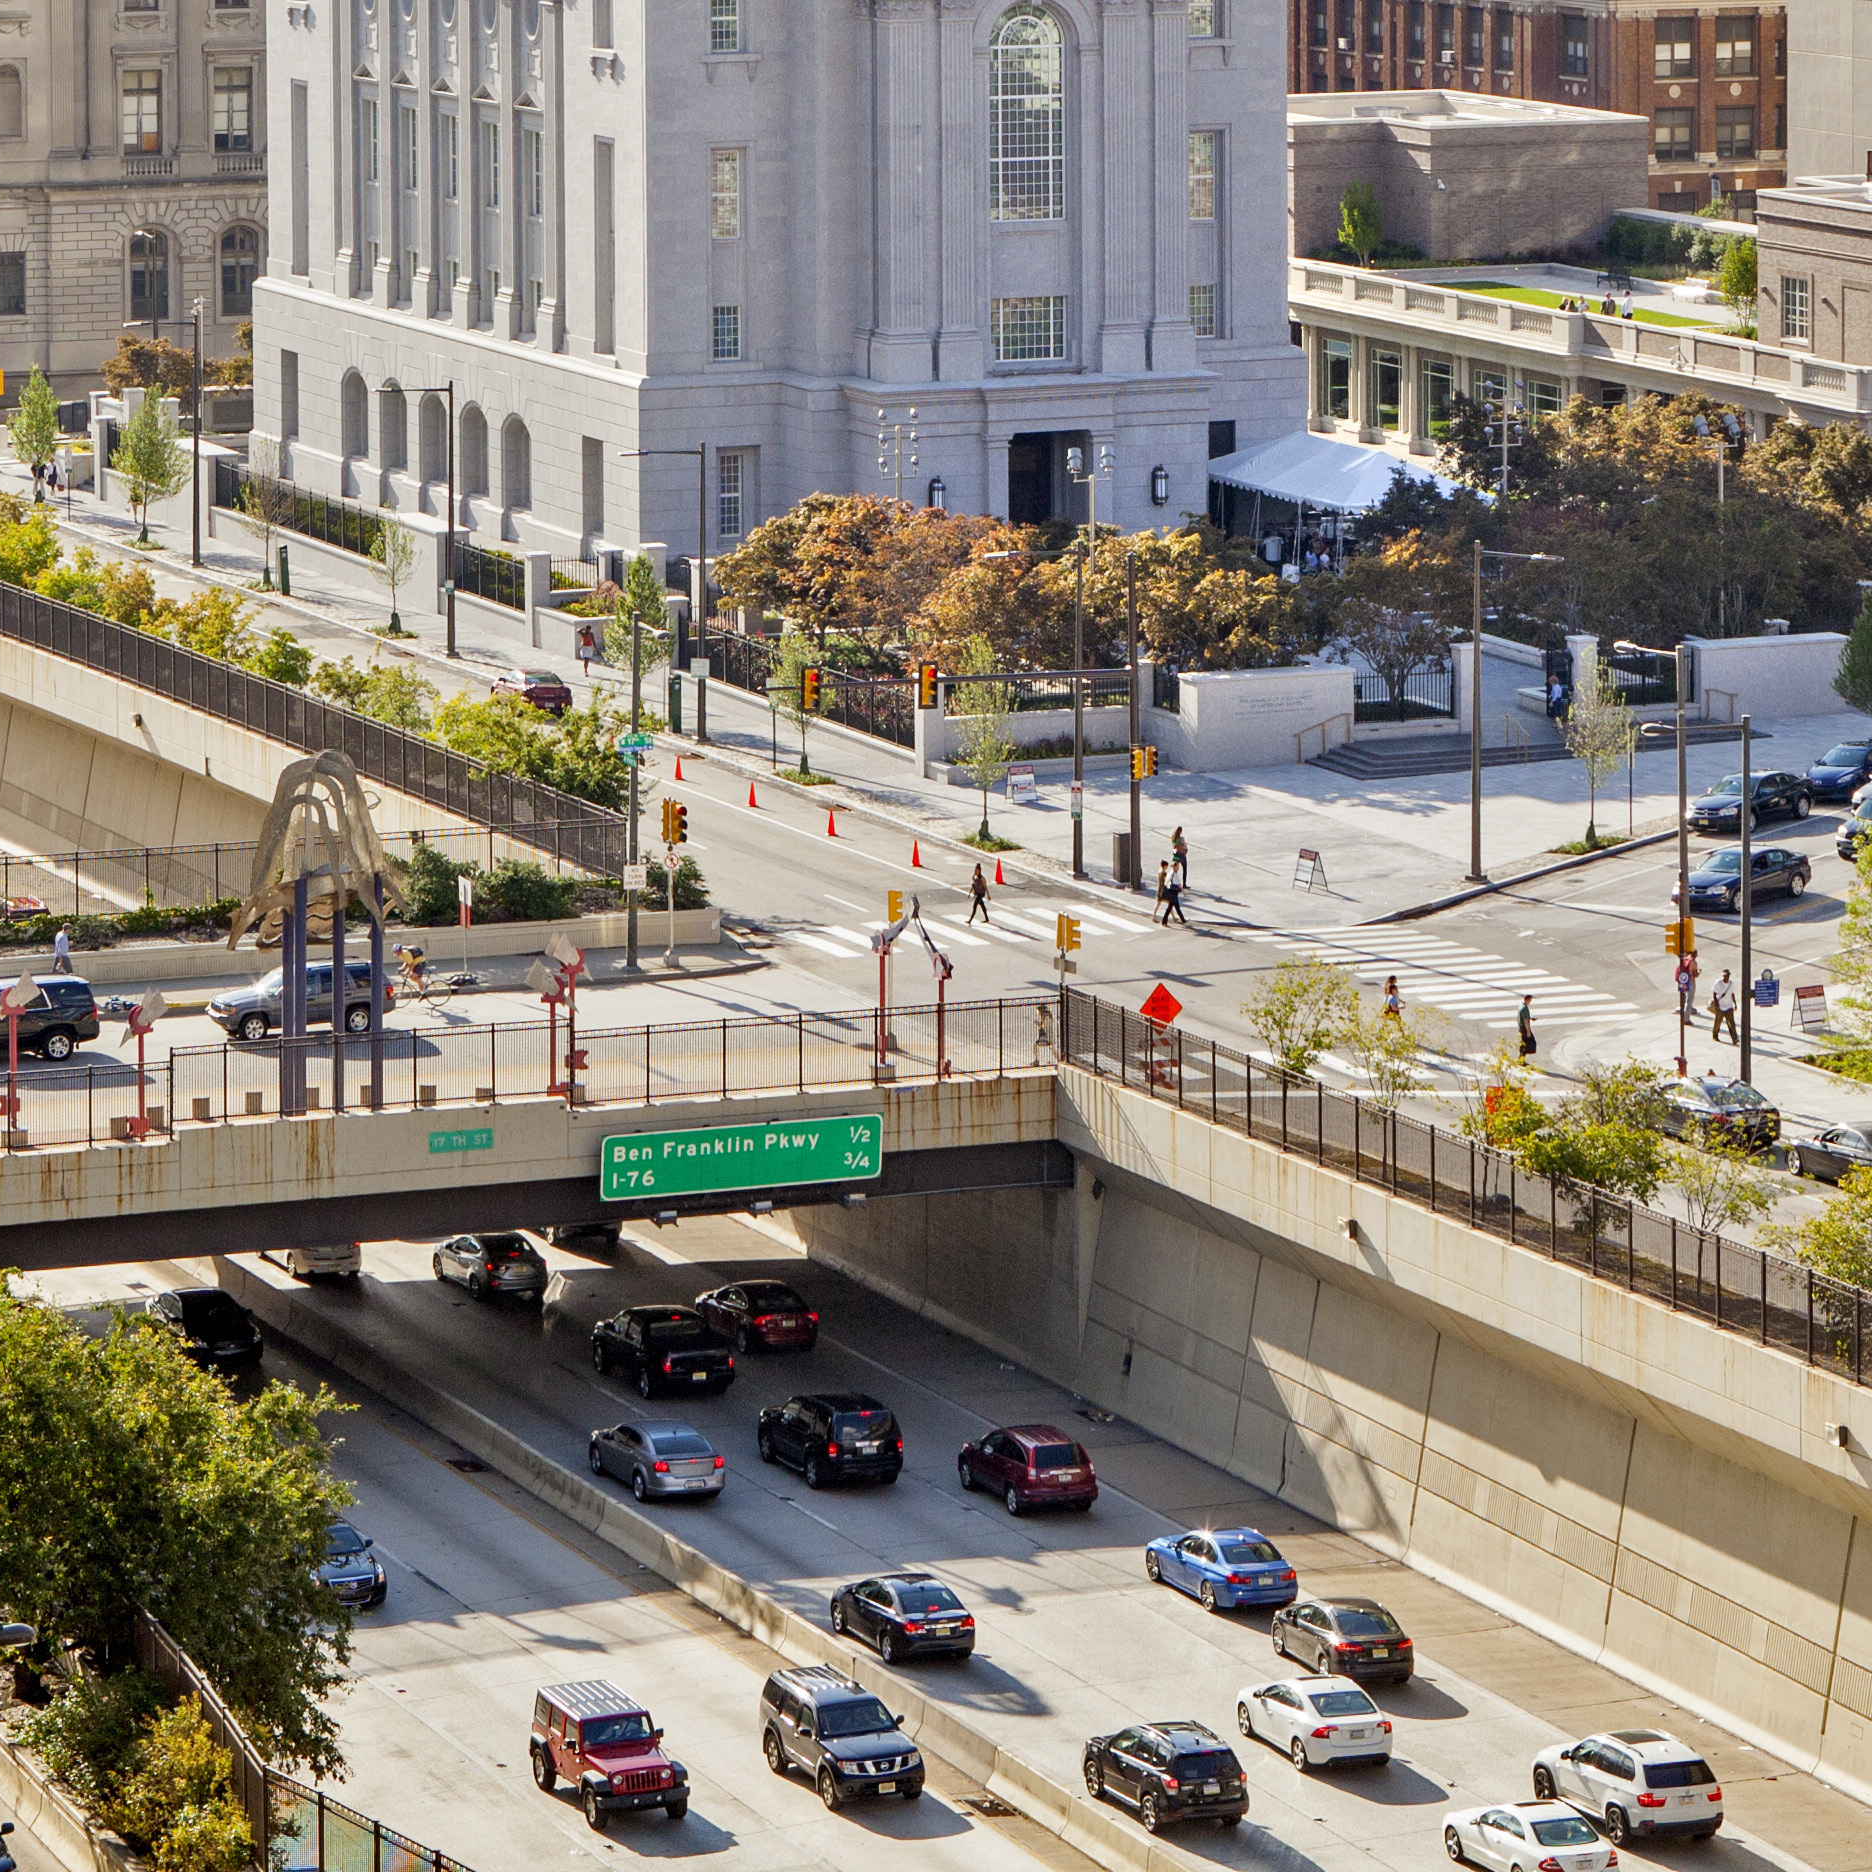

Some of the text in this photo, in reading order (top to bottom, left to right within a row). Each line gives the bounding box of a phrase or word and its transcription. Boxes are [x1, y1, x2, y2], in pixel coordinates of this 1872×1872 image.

[433, 1133, 488, 1148] 17 TH ST
[613, 1146, 653, 1163] Ben
[663, 1136, 754, 1159] Franklin
[765, 1133, 819, 1150] Pkwy
[613, 1169, 655, 1189] I-76
